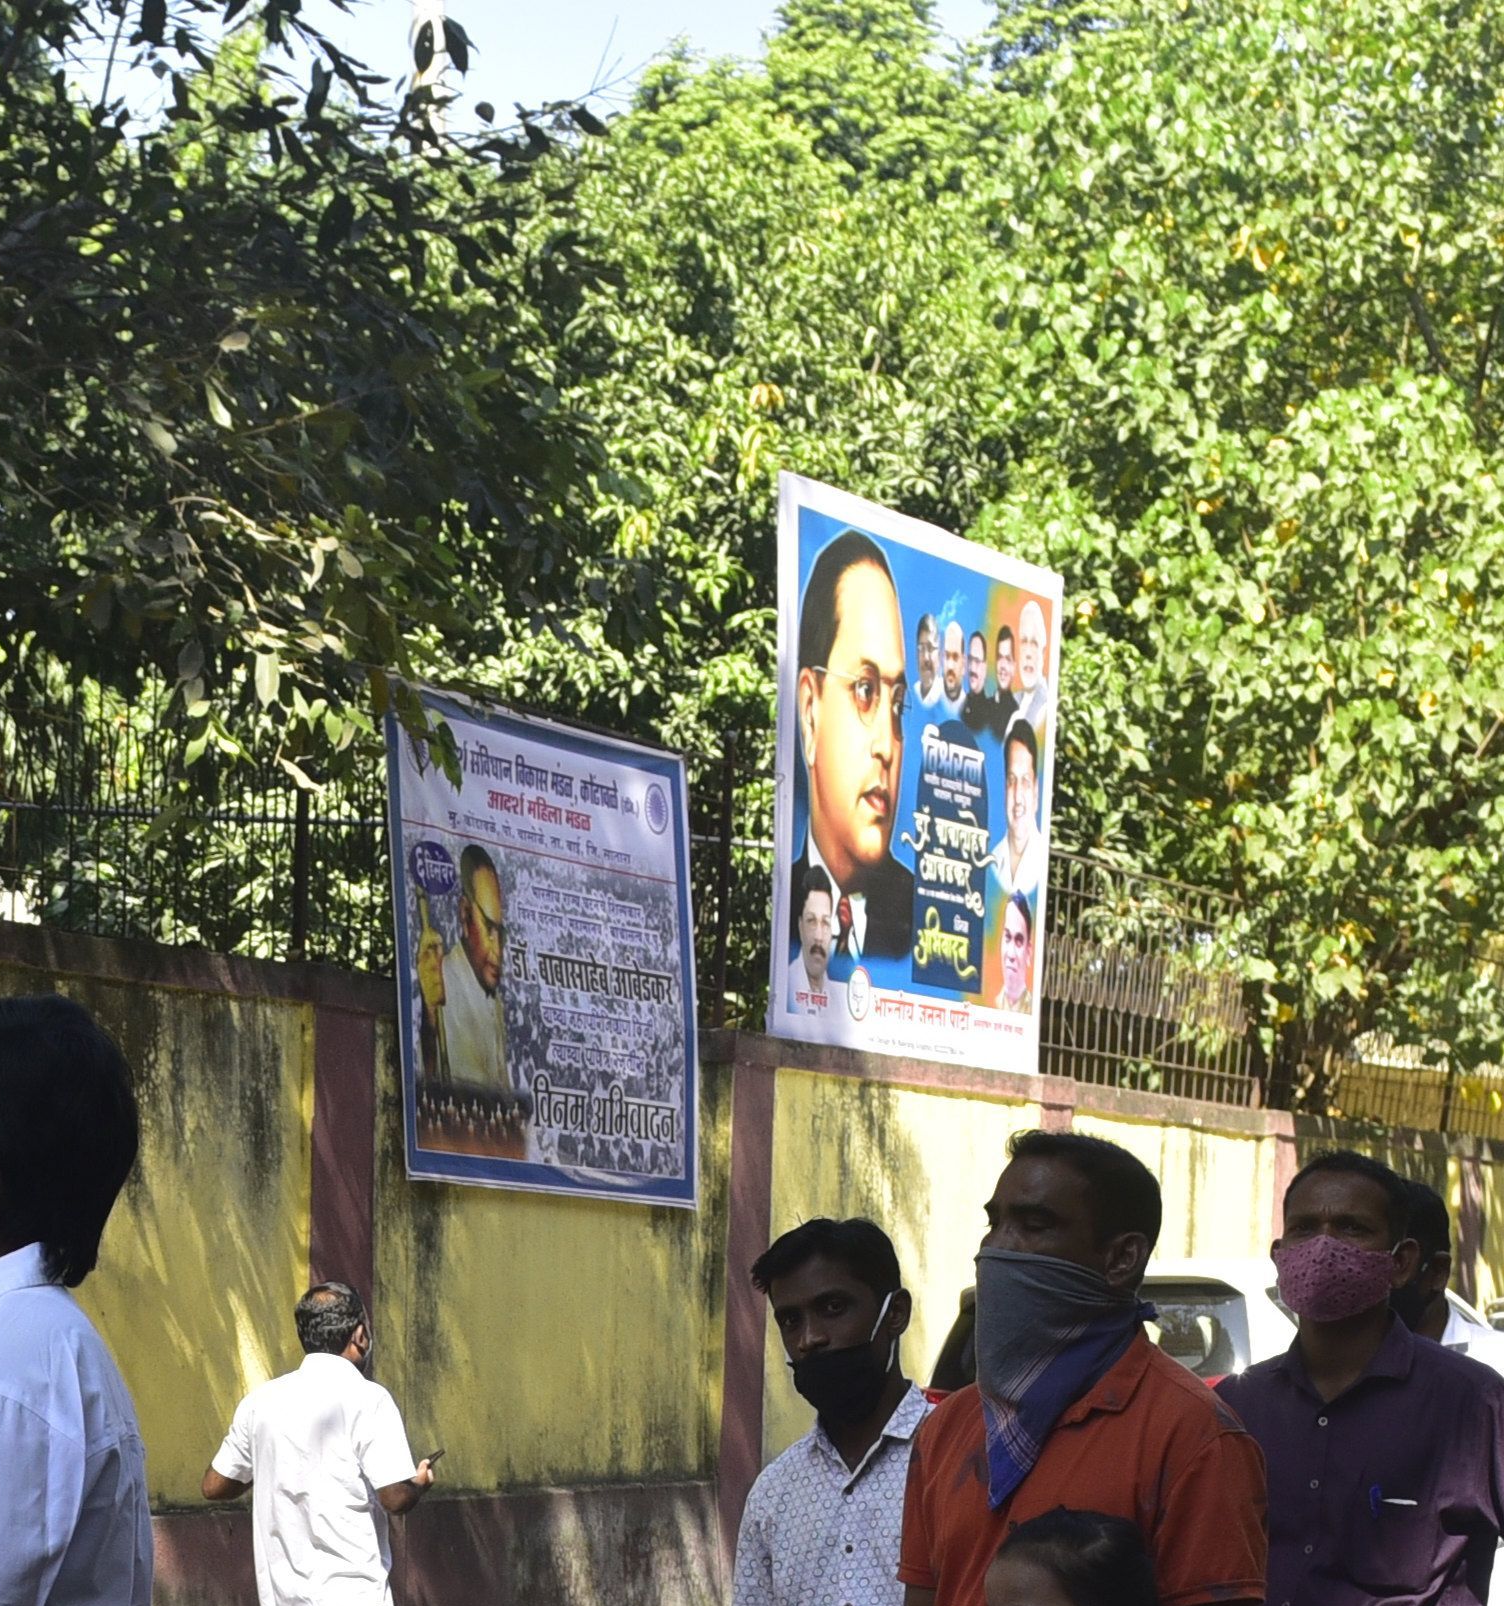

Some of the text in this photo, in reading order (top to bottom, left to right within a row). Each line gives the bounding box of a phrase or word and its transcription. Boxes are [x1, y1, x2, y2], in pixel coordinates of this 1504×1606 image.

[470, 740, 512, 784] संविधान
[515, 755, 548, 792] विकास
[921, 724, 985, 786] विश्वरत्न
[487, 789, 592, 832] आदर्श महिला मंडळ
[510, 940, 674, 1004] डॉ. बाबासाहेब आंबेडकर
[913, 906, 978, 980] अभिवादन
[874, 990, 914, 1022] भारतीय
[918, 1004, 947, 1027] जनता
[949, 1001, 971, 1032] पार्टी
[533, 1073, 677, 1144] विनम्र अभिवादन
